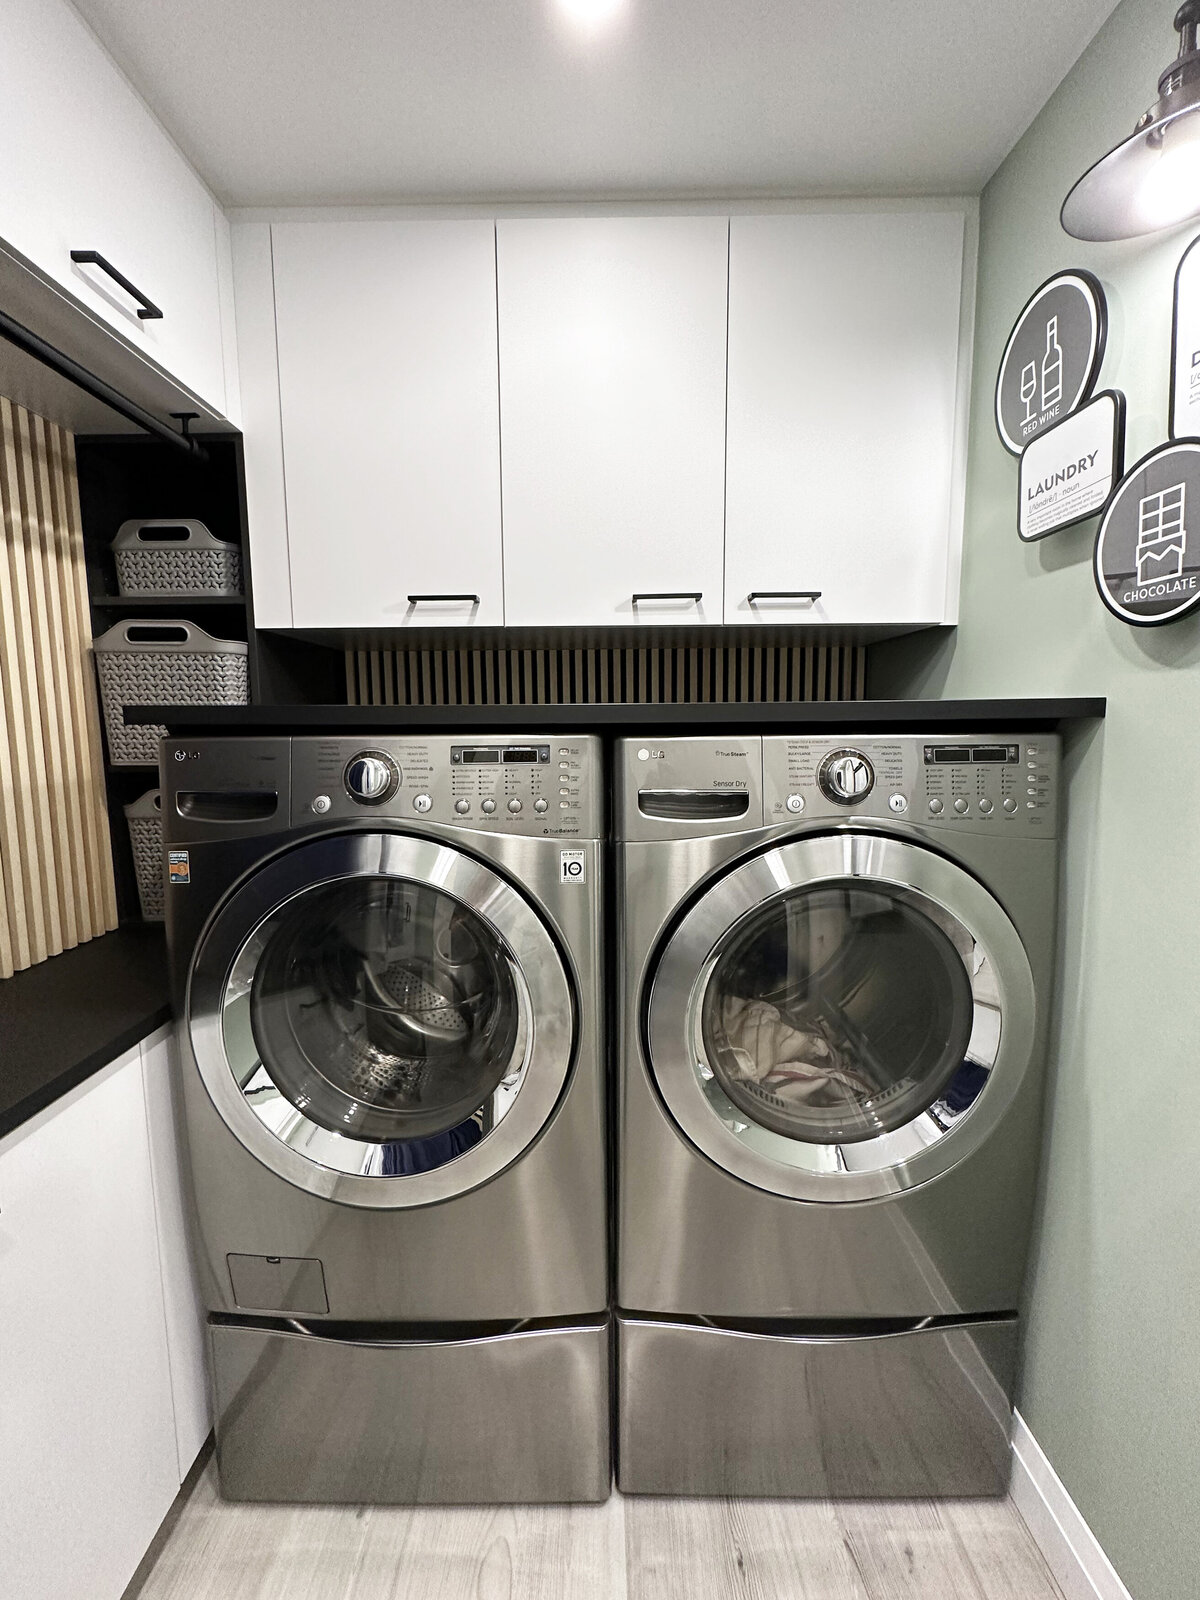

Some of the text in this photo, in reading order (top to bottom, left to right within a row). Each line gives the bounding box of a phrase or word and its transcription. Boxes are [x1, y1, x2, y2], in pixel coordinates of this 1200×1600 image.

[1022, 404, 1060, 436] RED WINE
[1028, 450, 1098, 500] LAUNDRY
[1062, 482, 1080, 496] noun
[1124, 576, 1196, 602] CHOCOLATE
[651, 750, 665, 759] LG
[563, 862, 582, 876] 10
